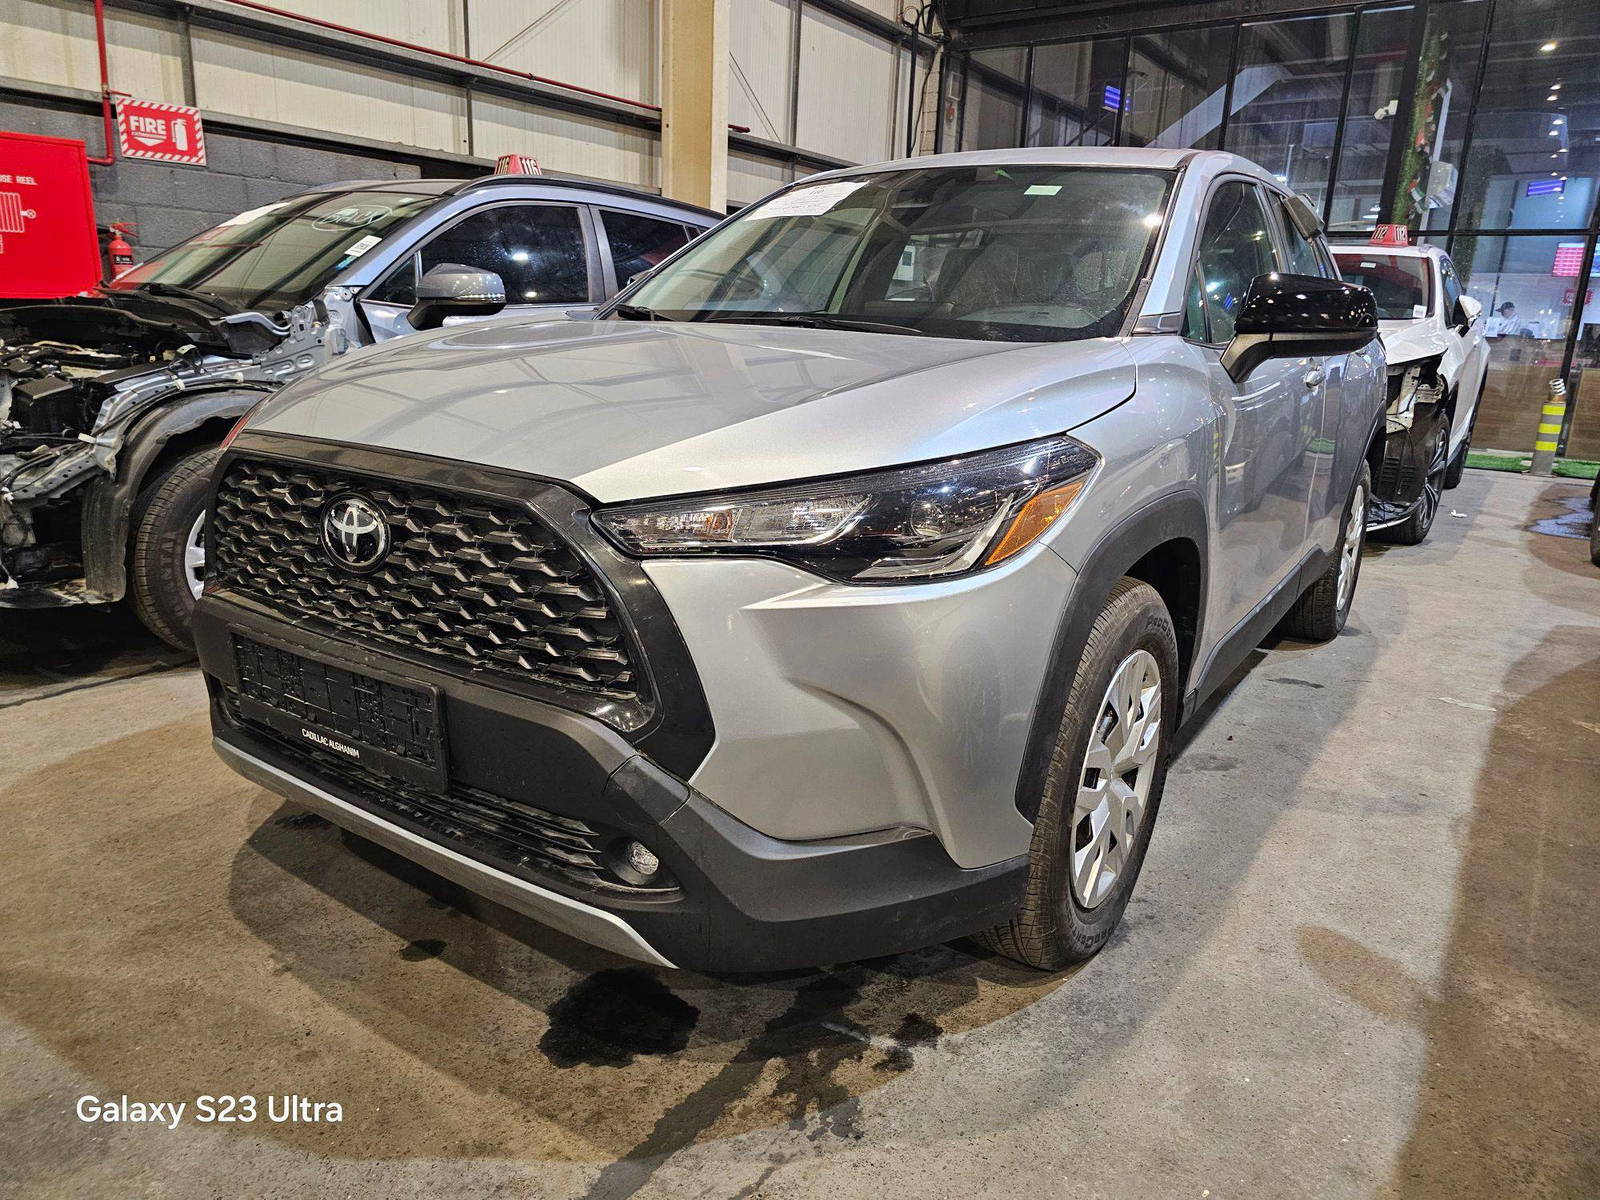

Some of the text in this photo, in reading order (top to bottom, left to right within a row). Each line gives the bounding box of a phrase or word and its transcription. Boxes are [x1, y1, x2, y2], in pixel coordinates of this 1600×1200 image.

[129, 115, 167, 135] FIRE
[521, 158, 540, 175] 116
[15, 175, 38, 186] REEL
[301, 728, 360, 758] CADILLAC ALGHANIM
